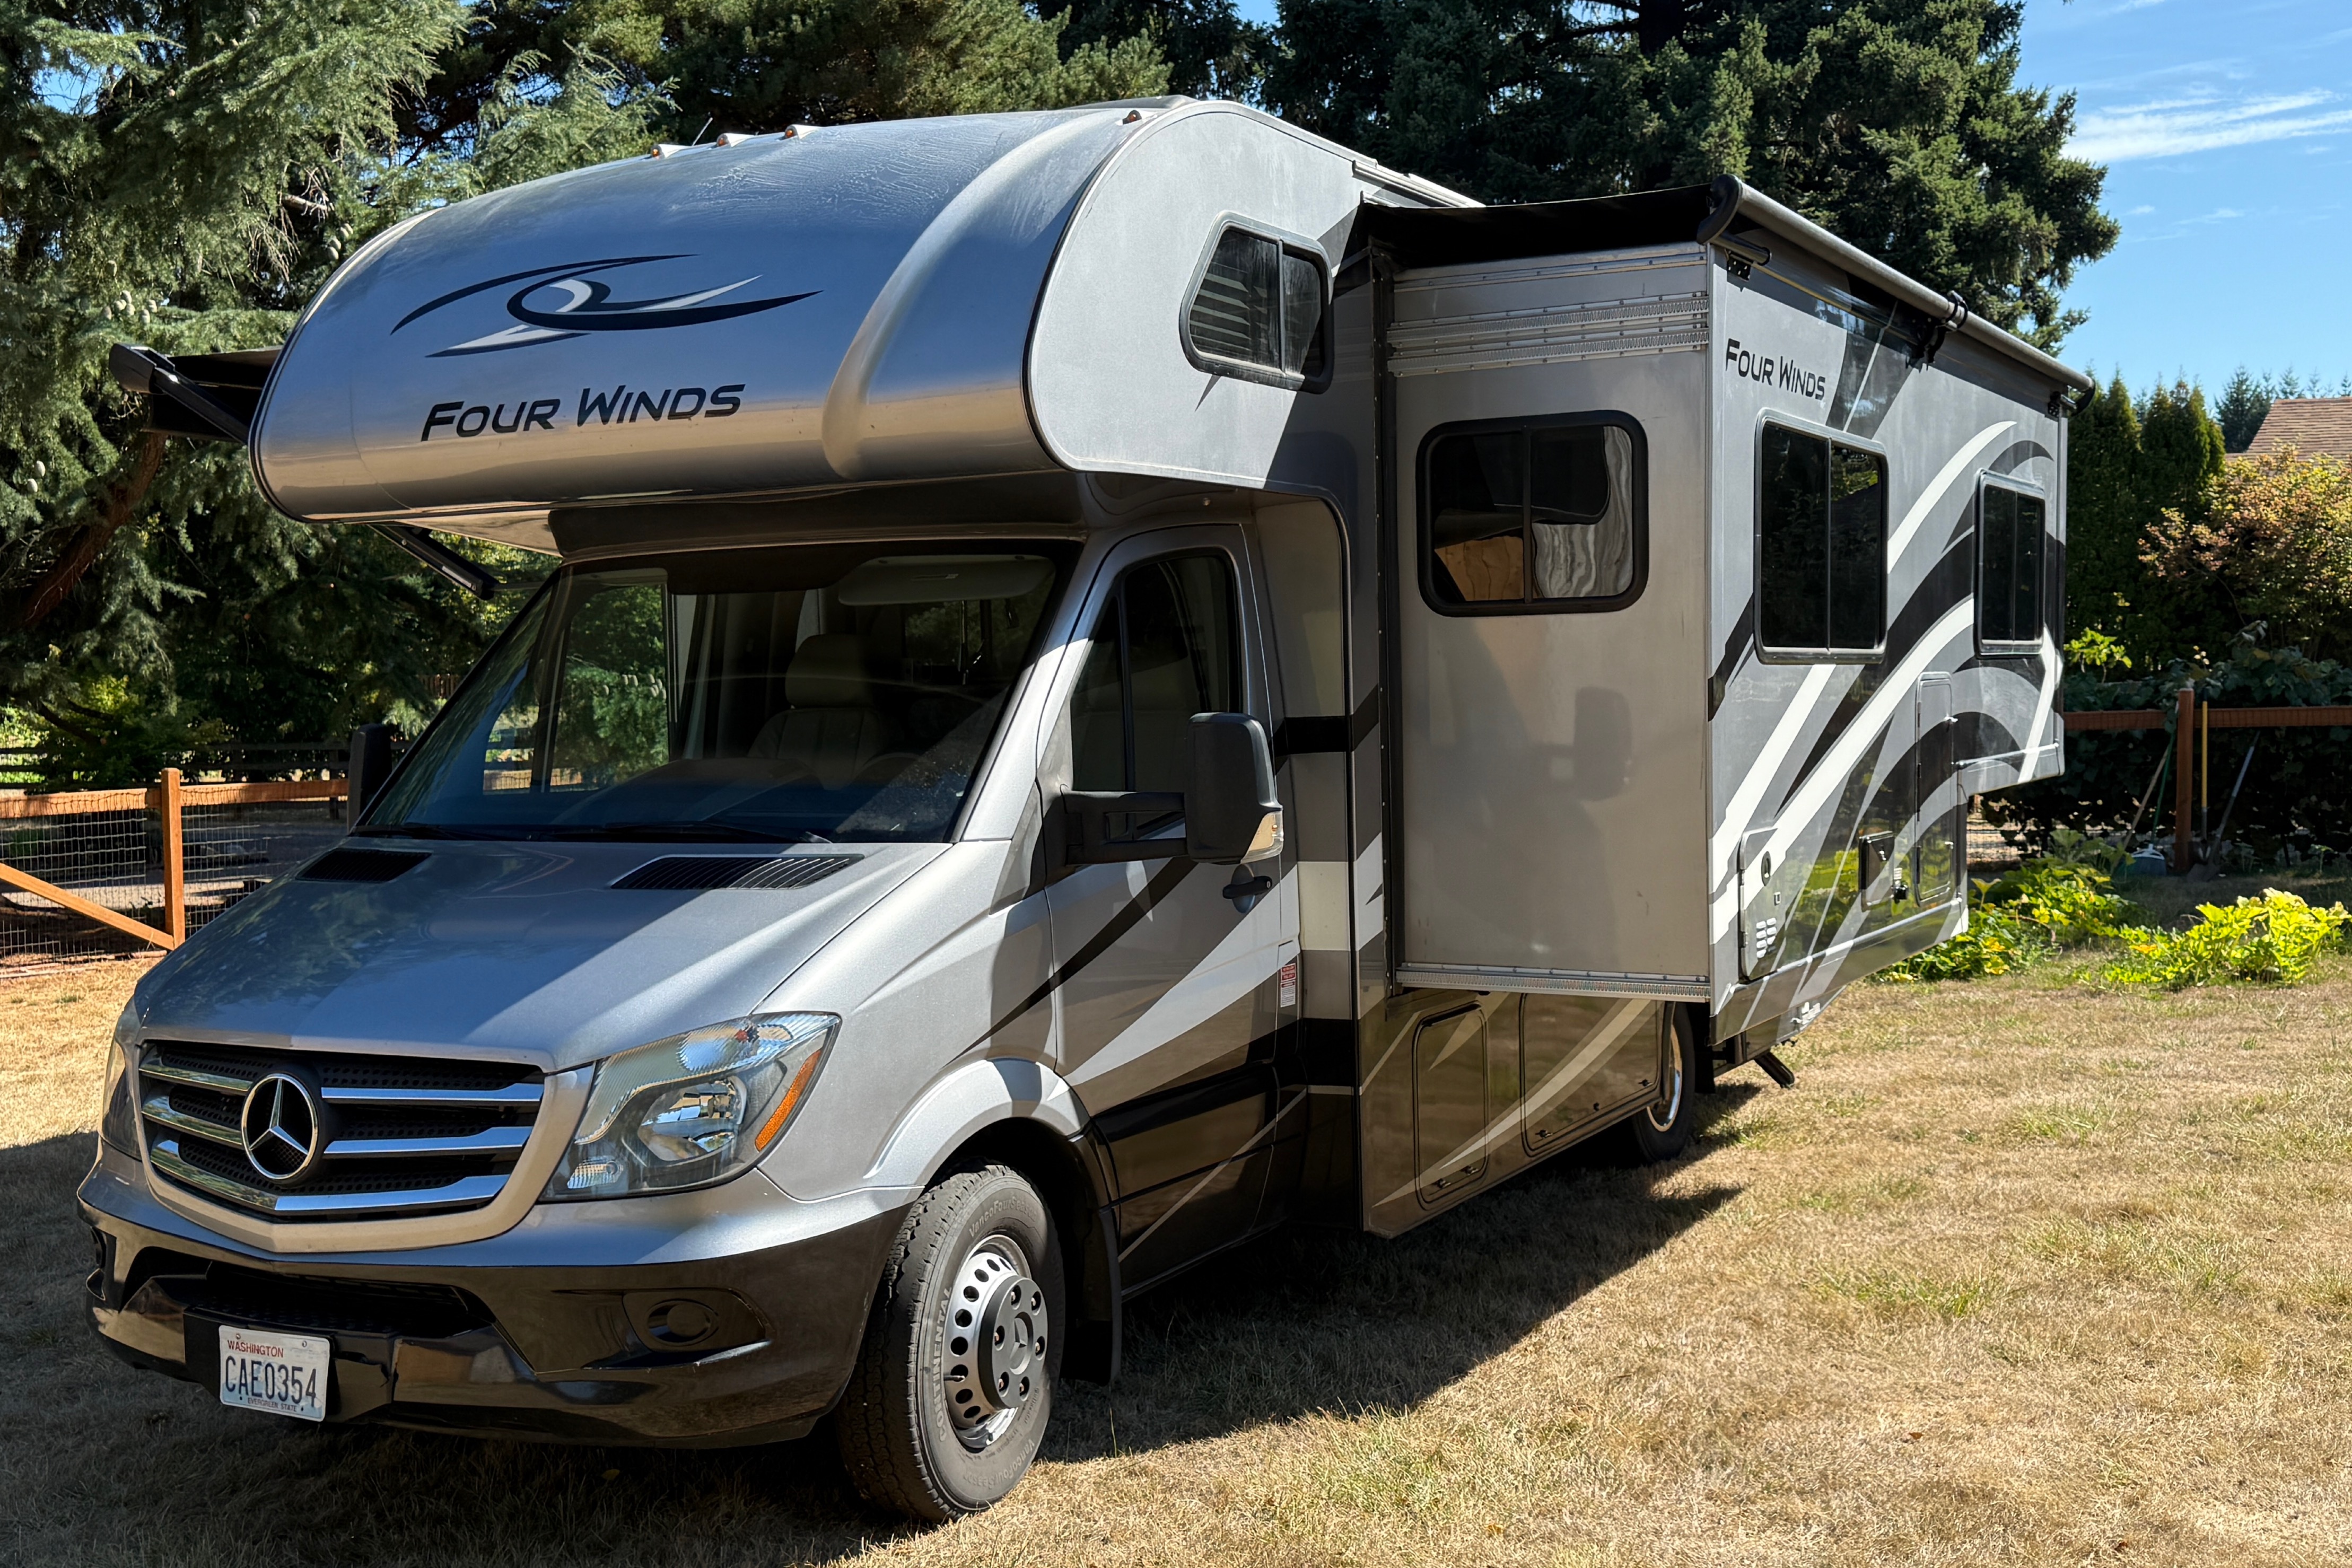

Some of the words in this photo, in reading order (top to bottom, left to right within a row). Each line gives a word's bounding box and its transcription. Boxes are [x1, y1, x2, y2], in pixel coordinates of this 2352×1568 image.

[1726, 338, 1774, 386] FOUR
[1779, 356, 1826, 400] WINDS
[421, 398, 561, 442] FOUR
[577, 384, 746, 427] WINDS
[228, 1339, 284, 1357] WASHINGTON
[933, 1287, 952, 1442] CONTINENTAL
[225, 1355, 317, 1407] CAE0354
[248, 1397, 278, 1408] EVERGREEN
